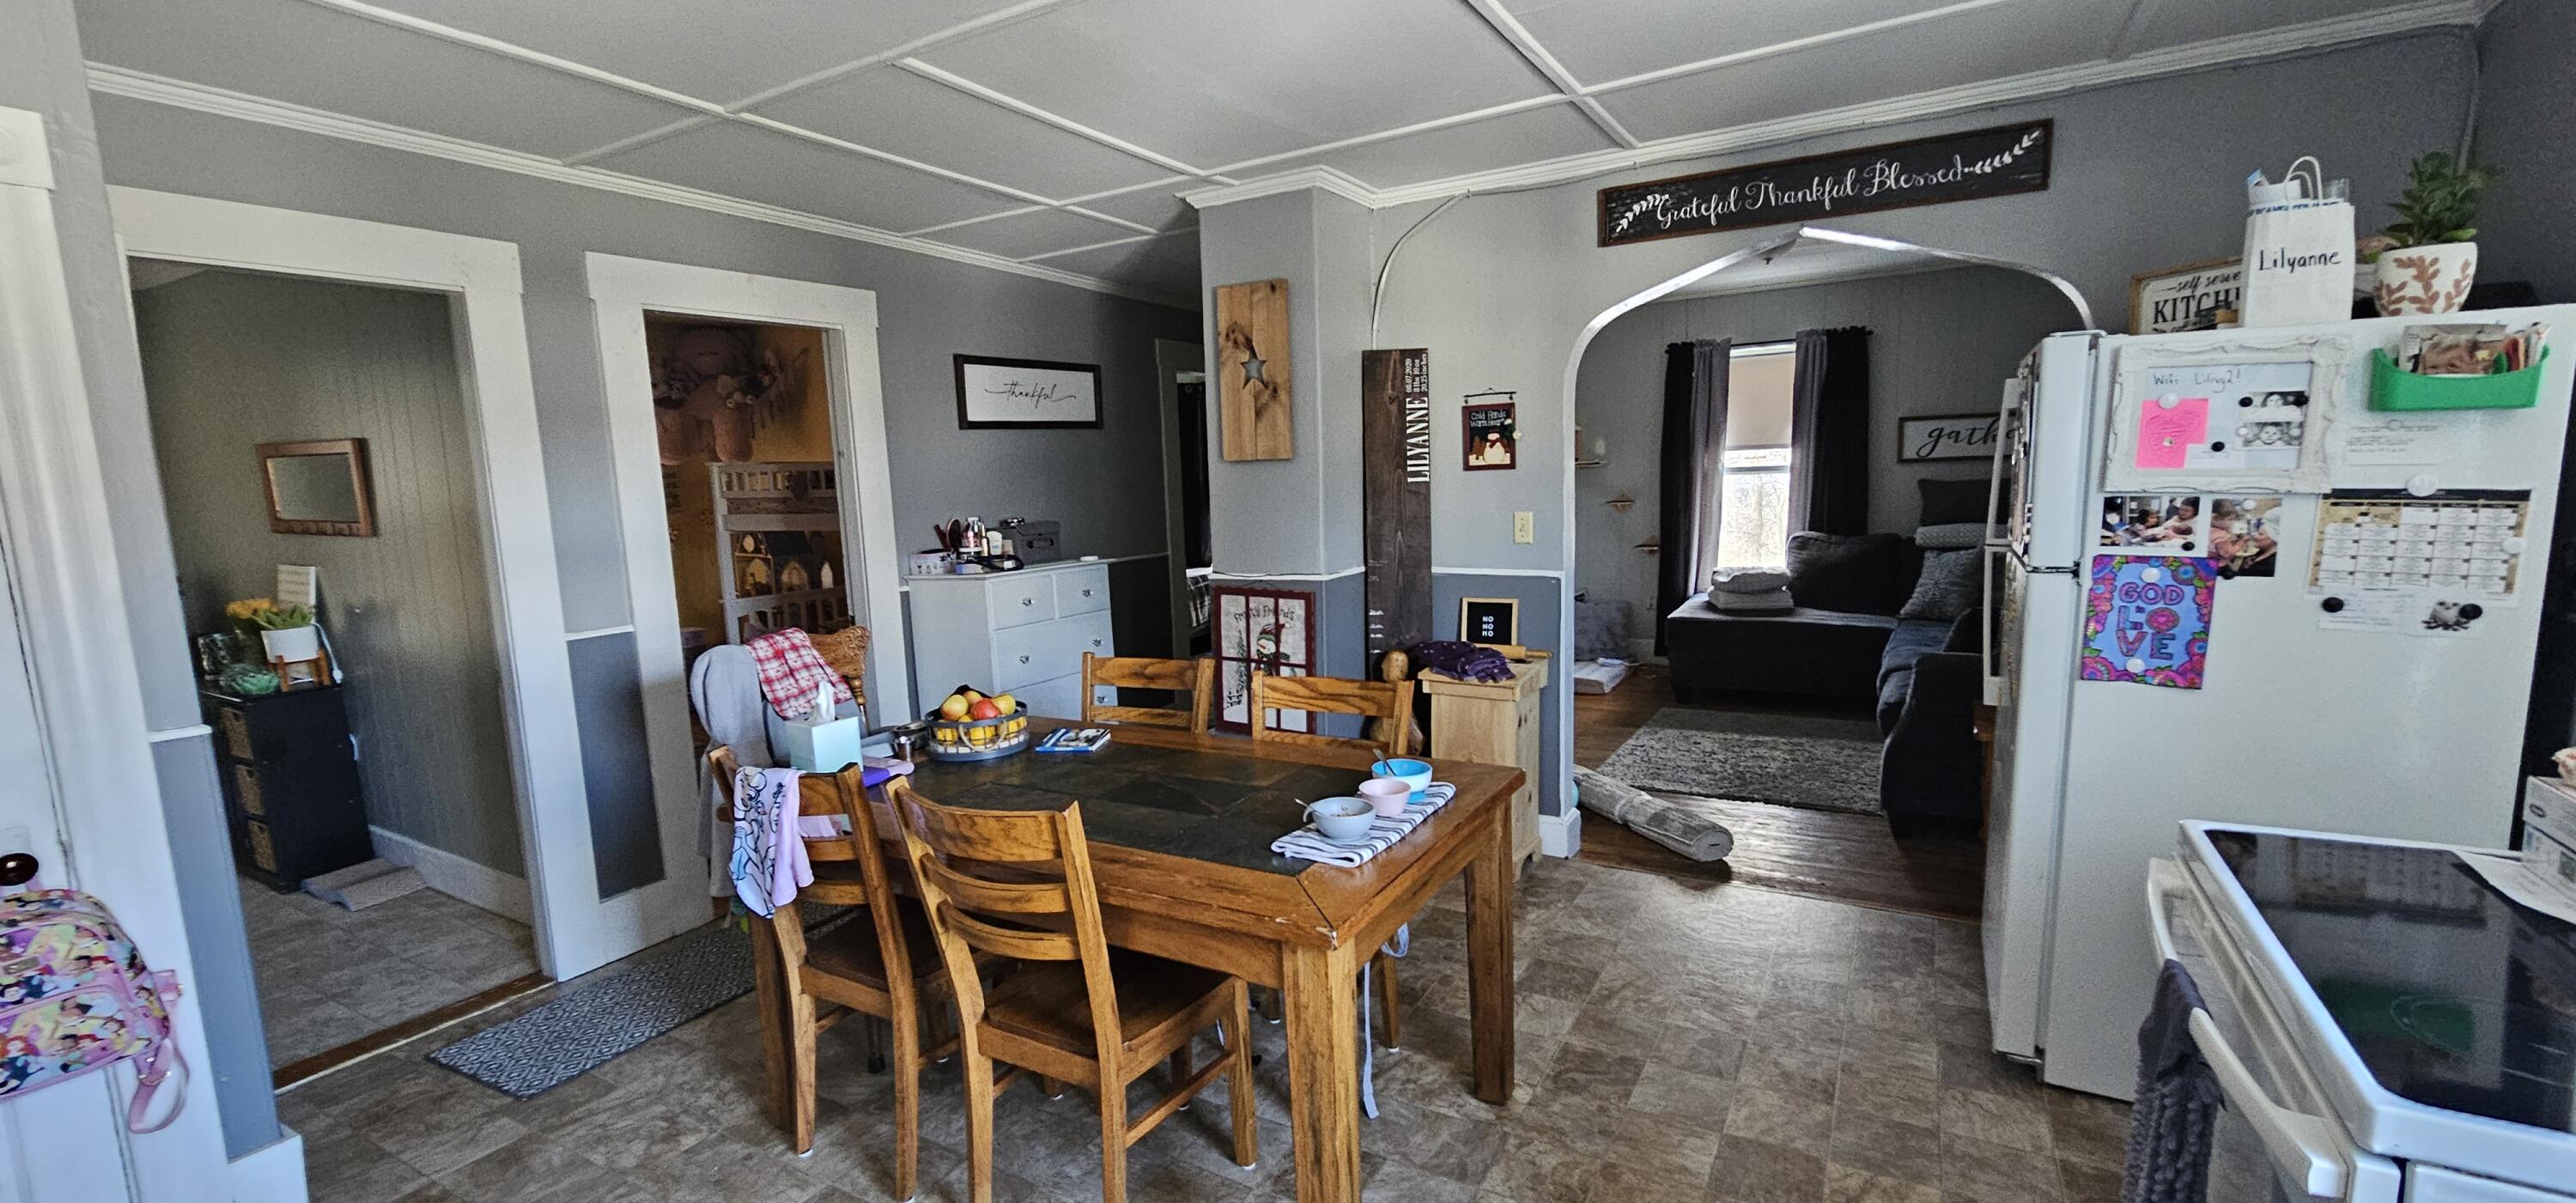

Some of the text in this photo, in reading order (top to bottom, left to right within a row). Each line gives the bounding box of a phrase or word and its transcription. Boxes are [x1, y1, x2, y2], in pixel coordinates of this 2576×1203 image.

[1656, 154, 1962, 229] Grateful Thankful Blessed
[2259, 247, 2342, 273] Lilyanne
[2178, 275, 2201, 293] self
[1470, 410, 1485, 421] Cold
[1406, 398, 1430, 483] LILYANNE
[2118, 582, 2184, 605] GOD
